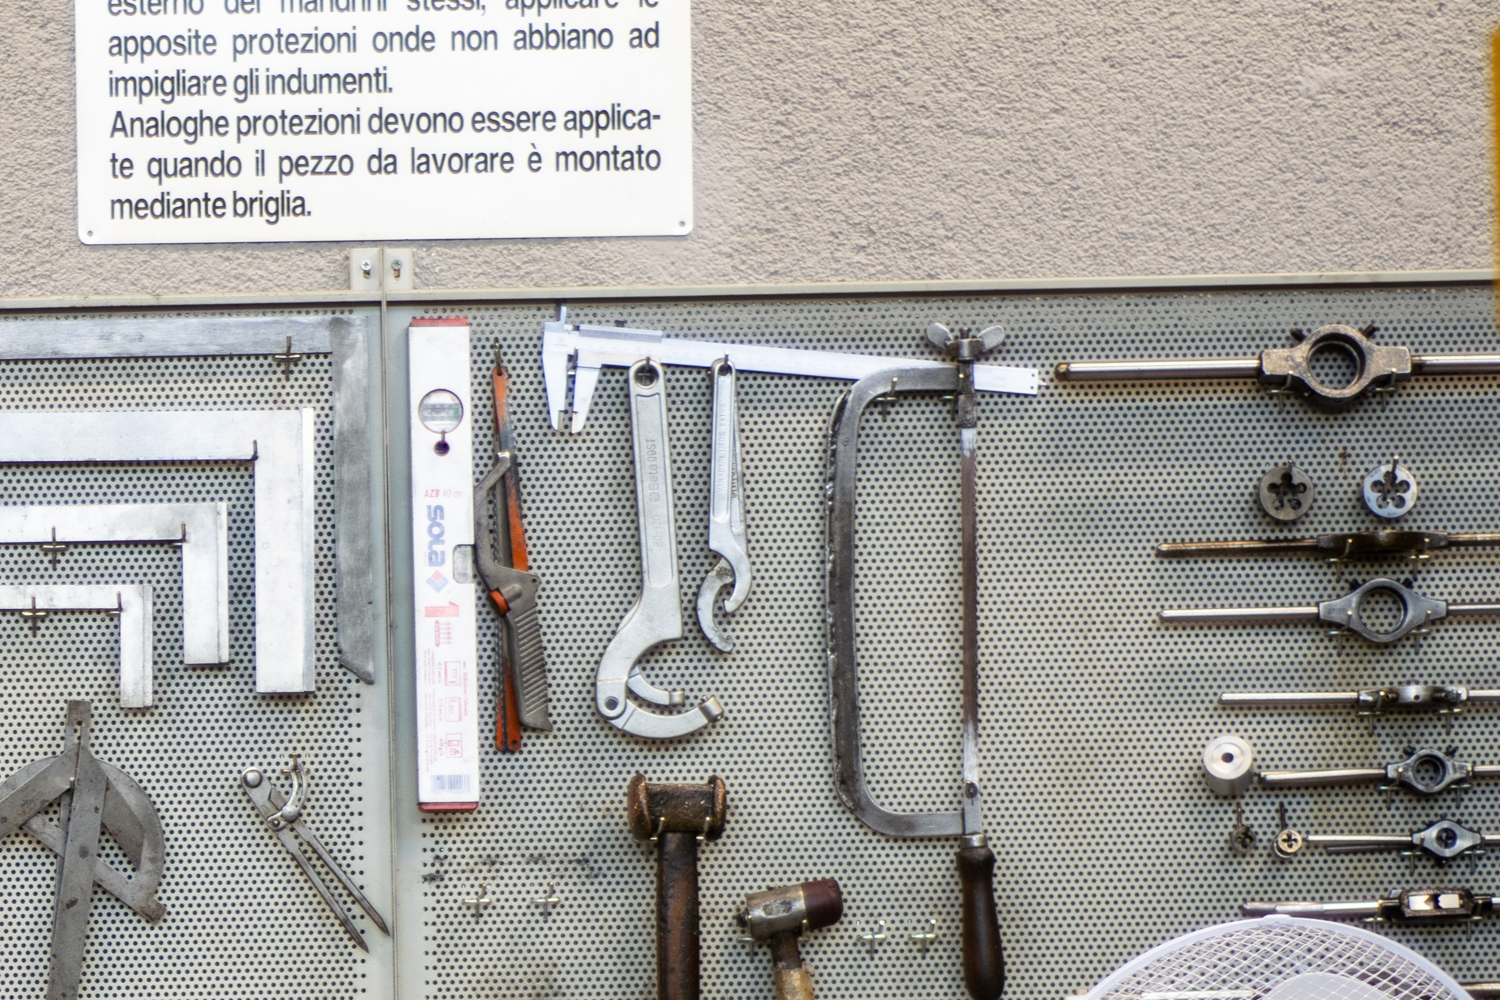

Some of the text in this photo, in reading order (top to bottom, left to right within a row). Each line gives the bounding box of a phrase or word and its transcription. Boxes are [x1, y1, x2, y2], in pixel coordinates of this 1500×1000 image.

[108, 21, 660, 64] apposite protezioni onde non abbiano ad
[108, 66, 393, 105] impigliare gli indumenti.
[110, 103, 662, 144] Analoghe protezioni devono essere applica-
[110, 144, 662, 186] te quando il pezzo da lavorare è montato
[110, 190, 312, 226] mediante briglia.
[647, 464, 660, 491] Beta
